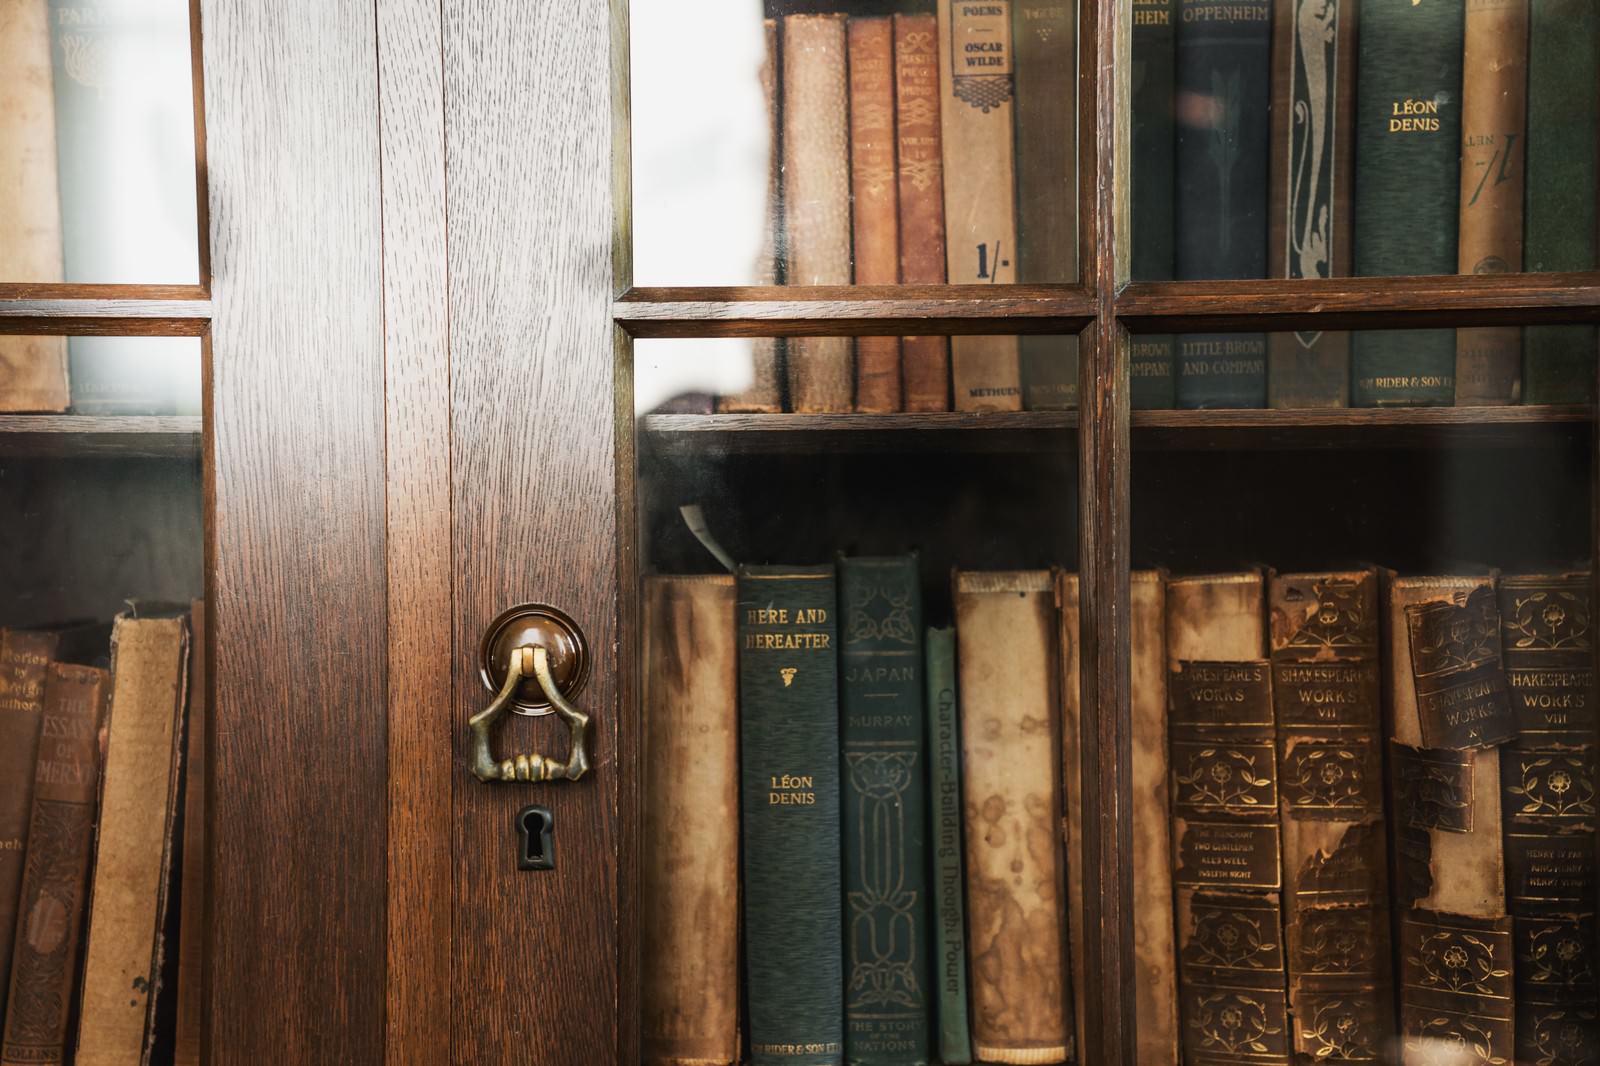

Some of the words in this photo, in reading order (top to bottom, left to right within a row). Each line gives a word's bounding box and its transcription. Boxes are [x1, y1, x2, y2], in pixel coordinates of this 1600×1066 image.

[962, 6, 1003, 17] POEMS
[1182, 5, 1269, 22] OPPENHEIM
[964, 41, 1003, 53] OSCAR
[965, 55, 1004, 67] WILDE
[1392, 99, 1439, 116] LÉON
[1389, 117, 1441, 133] DENIS
[1182, 359, 1210, 377] AND
[1375, 376, 1409, 389] RIDER
[1409, 376, 1421, 388] &
[1420, 375, 1441, 388] SON
[748, 608, 789, 625] HERE
[795, 608, 827, 624] AND
[745, 633, 831, 649] HEREAFTER
[846, 666, 915, 683] JAPAN
[1190, 687, 1245, 702] WORKS
[1298, 688, 1358, 703] WORKS
[1523, 694, 1585, 708] WORKS
[0, 698, 42, 713] uthors
[1317, 708, 1336, 719] VII
[1445, 701, 1497, 727] WORKS
[1545, 714, 1567, 724] VIII
[849, 714, 914, 728] MURRAY
[771, 774, 814, 790] LÉON
[768, 793, 816, 805] DENIS
[1223, 857, 1248, 866] WELL
[1229, 871, 1252, 880] NIGHT
[942, 865, 962, 935] Thought
[945, 938, 964, 995] Power
[849, 1021, 873, 1033] THE
[879, 1020, 923, 1032] STORY
[763, 1043, 795, 1056] RIDER
[795, 1044, 805, 1056] &
[804, 1042, 825, 1055] SON
[853, 1040, 917, 1052] NATIONS
[5, 1048, 59, 1061] COLLINS
